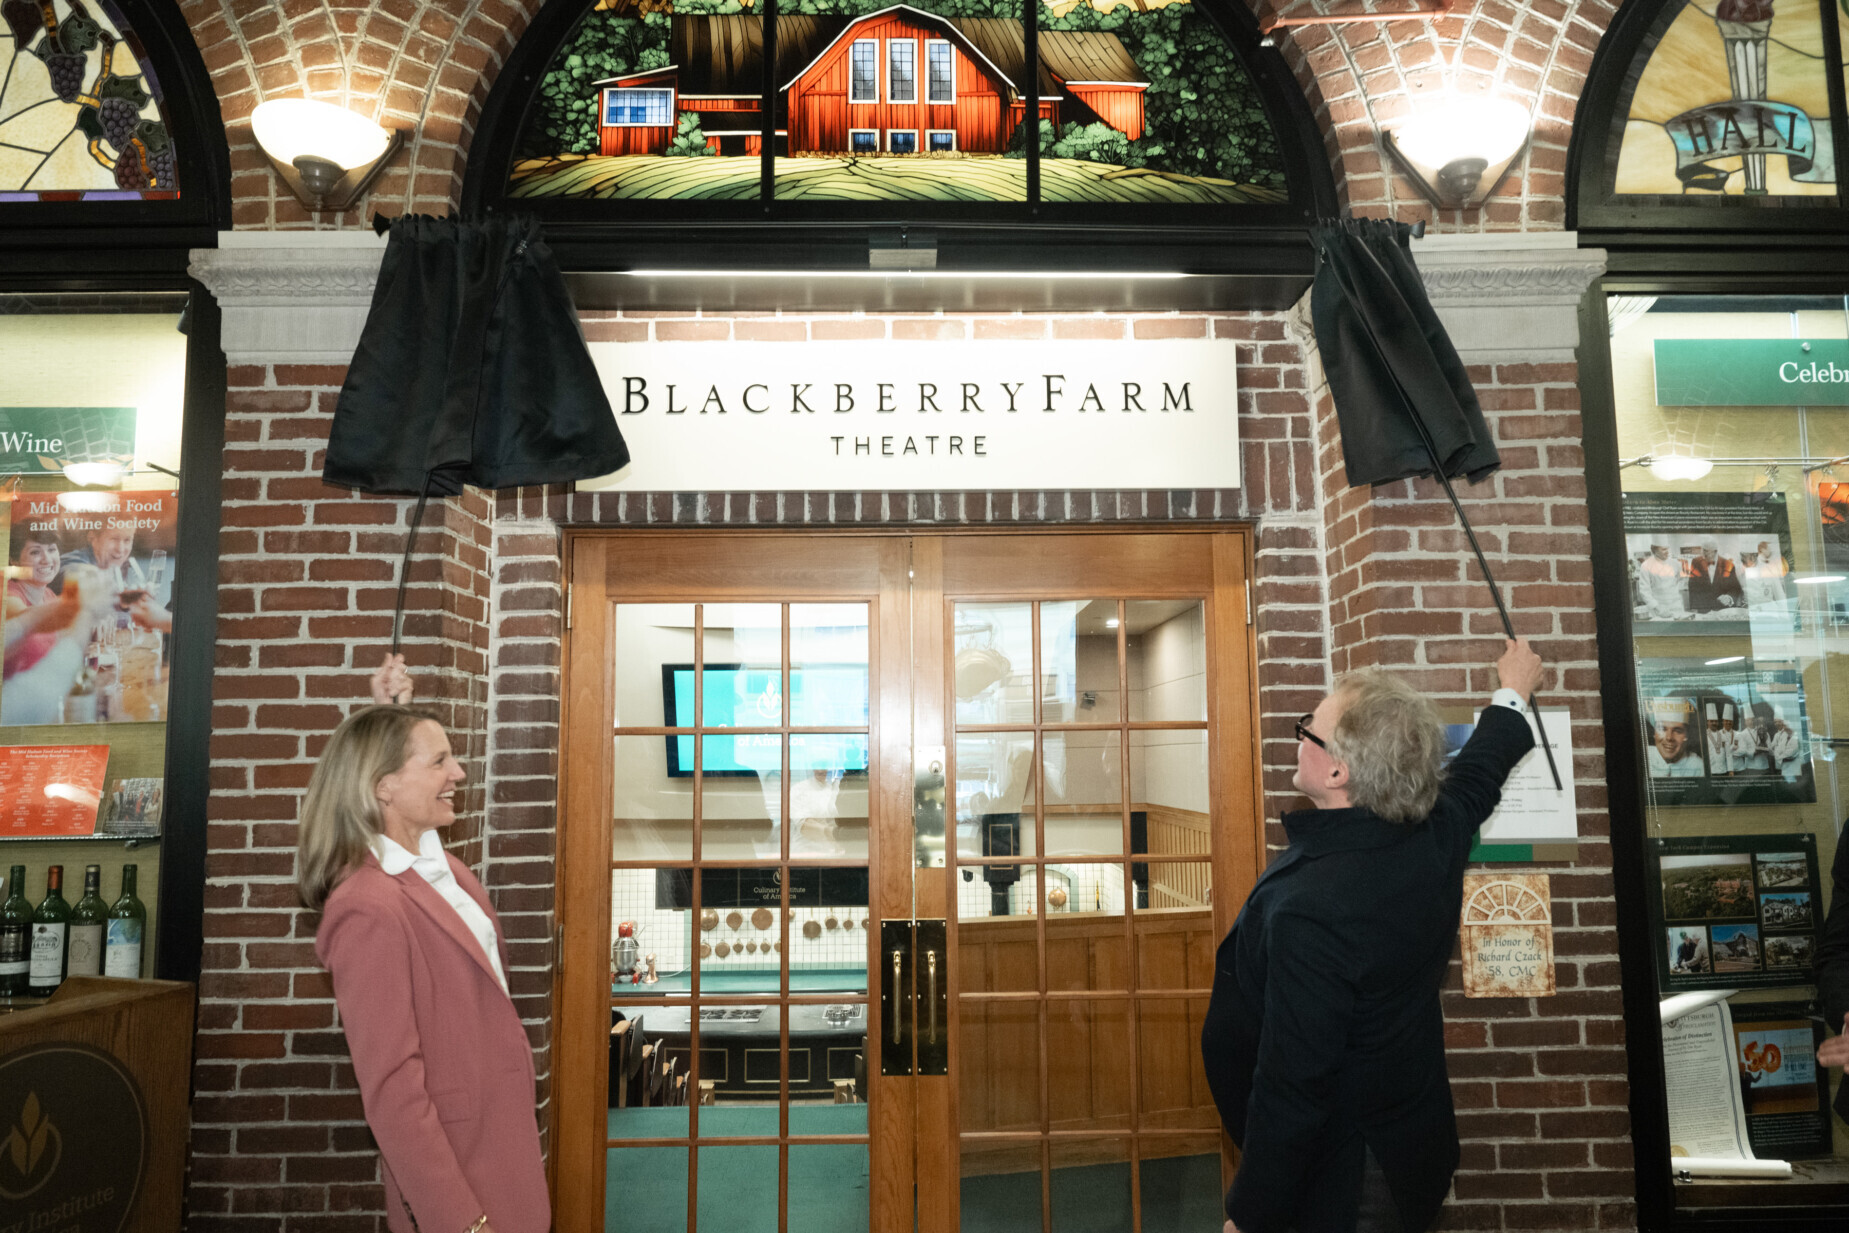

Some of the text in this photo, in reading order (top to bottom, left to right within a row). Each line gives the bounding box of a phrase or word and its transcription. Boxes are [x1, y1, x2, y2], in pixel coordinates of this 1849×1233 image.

[1682, 107, 1806, 157] HALL
[0, 431, 63, 453] Wine
[830, 435, 987, 456] THEATRE
[30, 501, 60, 514] Mid
[126, 498, 162, 513] Food
[30, 516, 161, 532] and Wine Society
[753, 886, 781, 894] Culinary
[1483, 935, 1535, 951] In Honor of
[1477, 949, 1542, 962] Richard Czack
[1508, 965, 1537, 978] CMC
